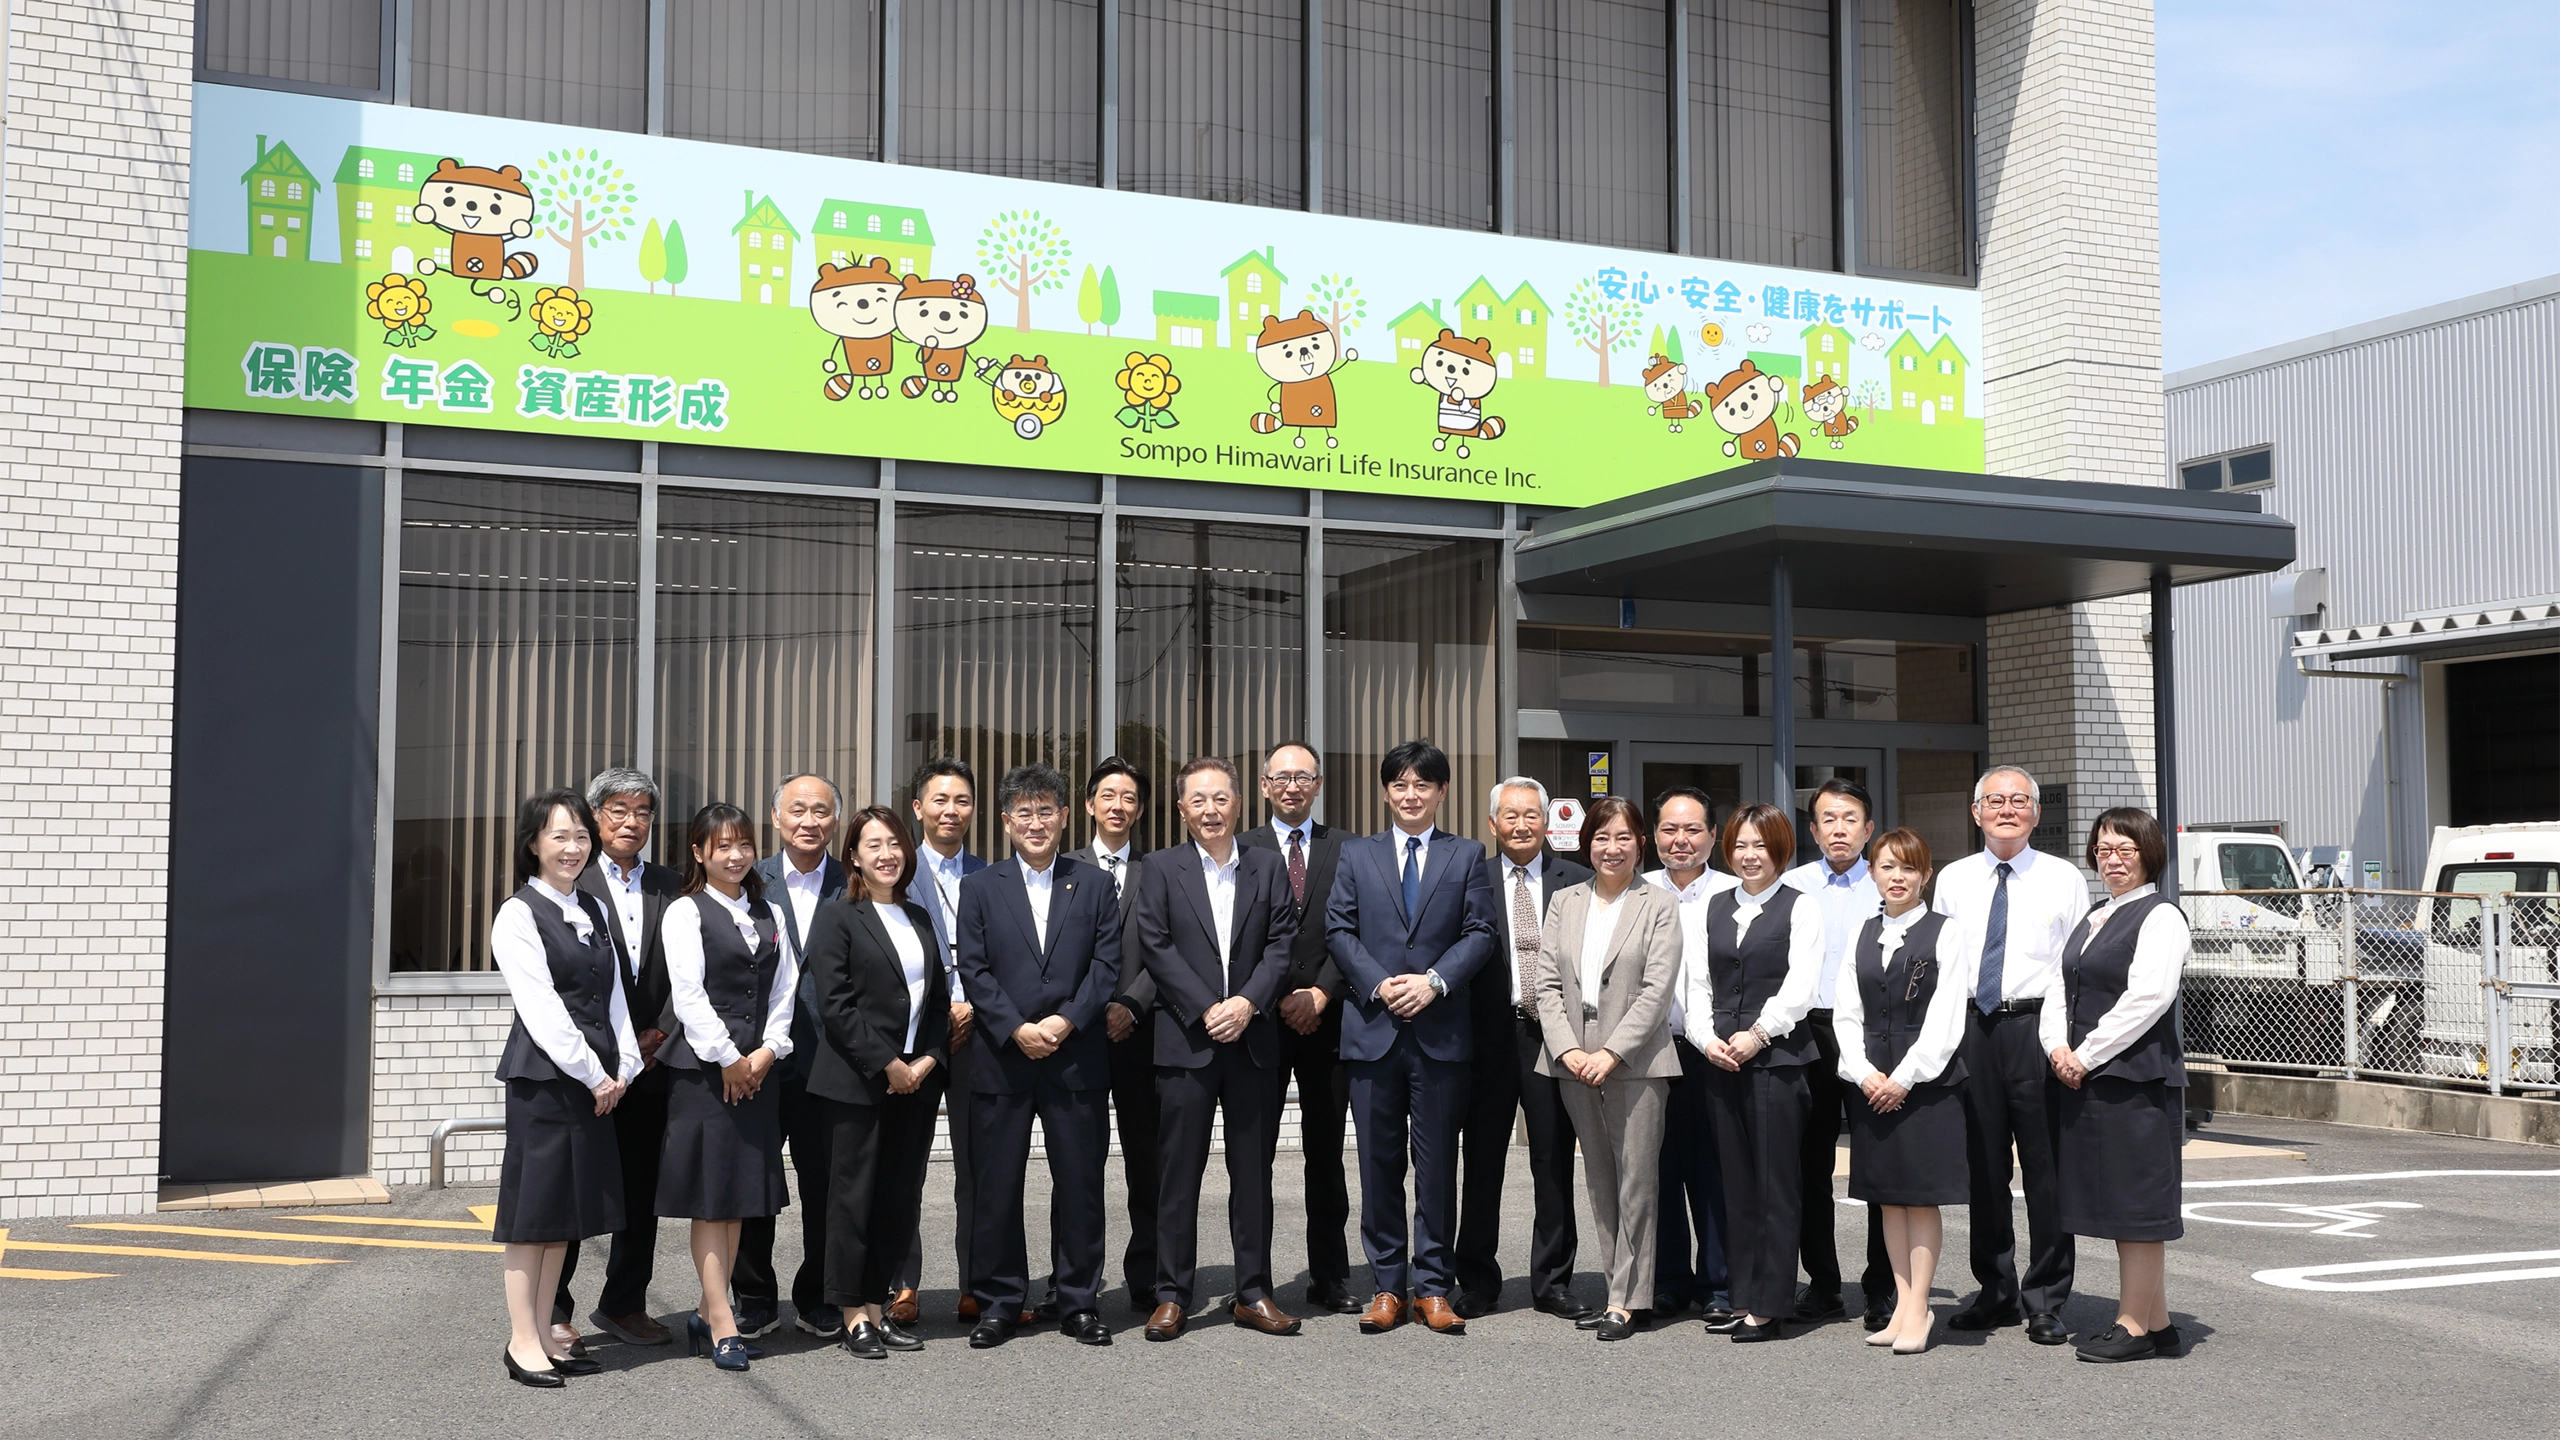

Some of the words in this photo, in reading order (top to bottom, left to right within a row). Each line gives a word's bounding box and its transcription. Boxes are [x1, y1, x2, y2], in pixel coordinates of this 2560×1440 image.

[1598, 266, 1952, 334] 安心・安全・健康をサポート
[247, 346, 357, 398] 保険
[386, 359, 489, 408] 年金
[521, 369, 724, 428] 資産形成
[1119, 436, 1208, 467] Sompo
[1215, 443, 1332, 473] Himawari
[1339, 453, 1382, 477] Life
[1389, 456, 1498, 486] Insurance
[1504, 466, 1542, 489] Inc.
